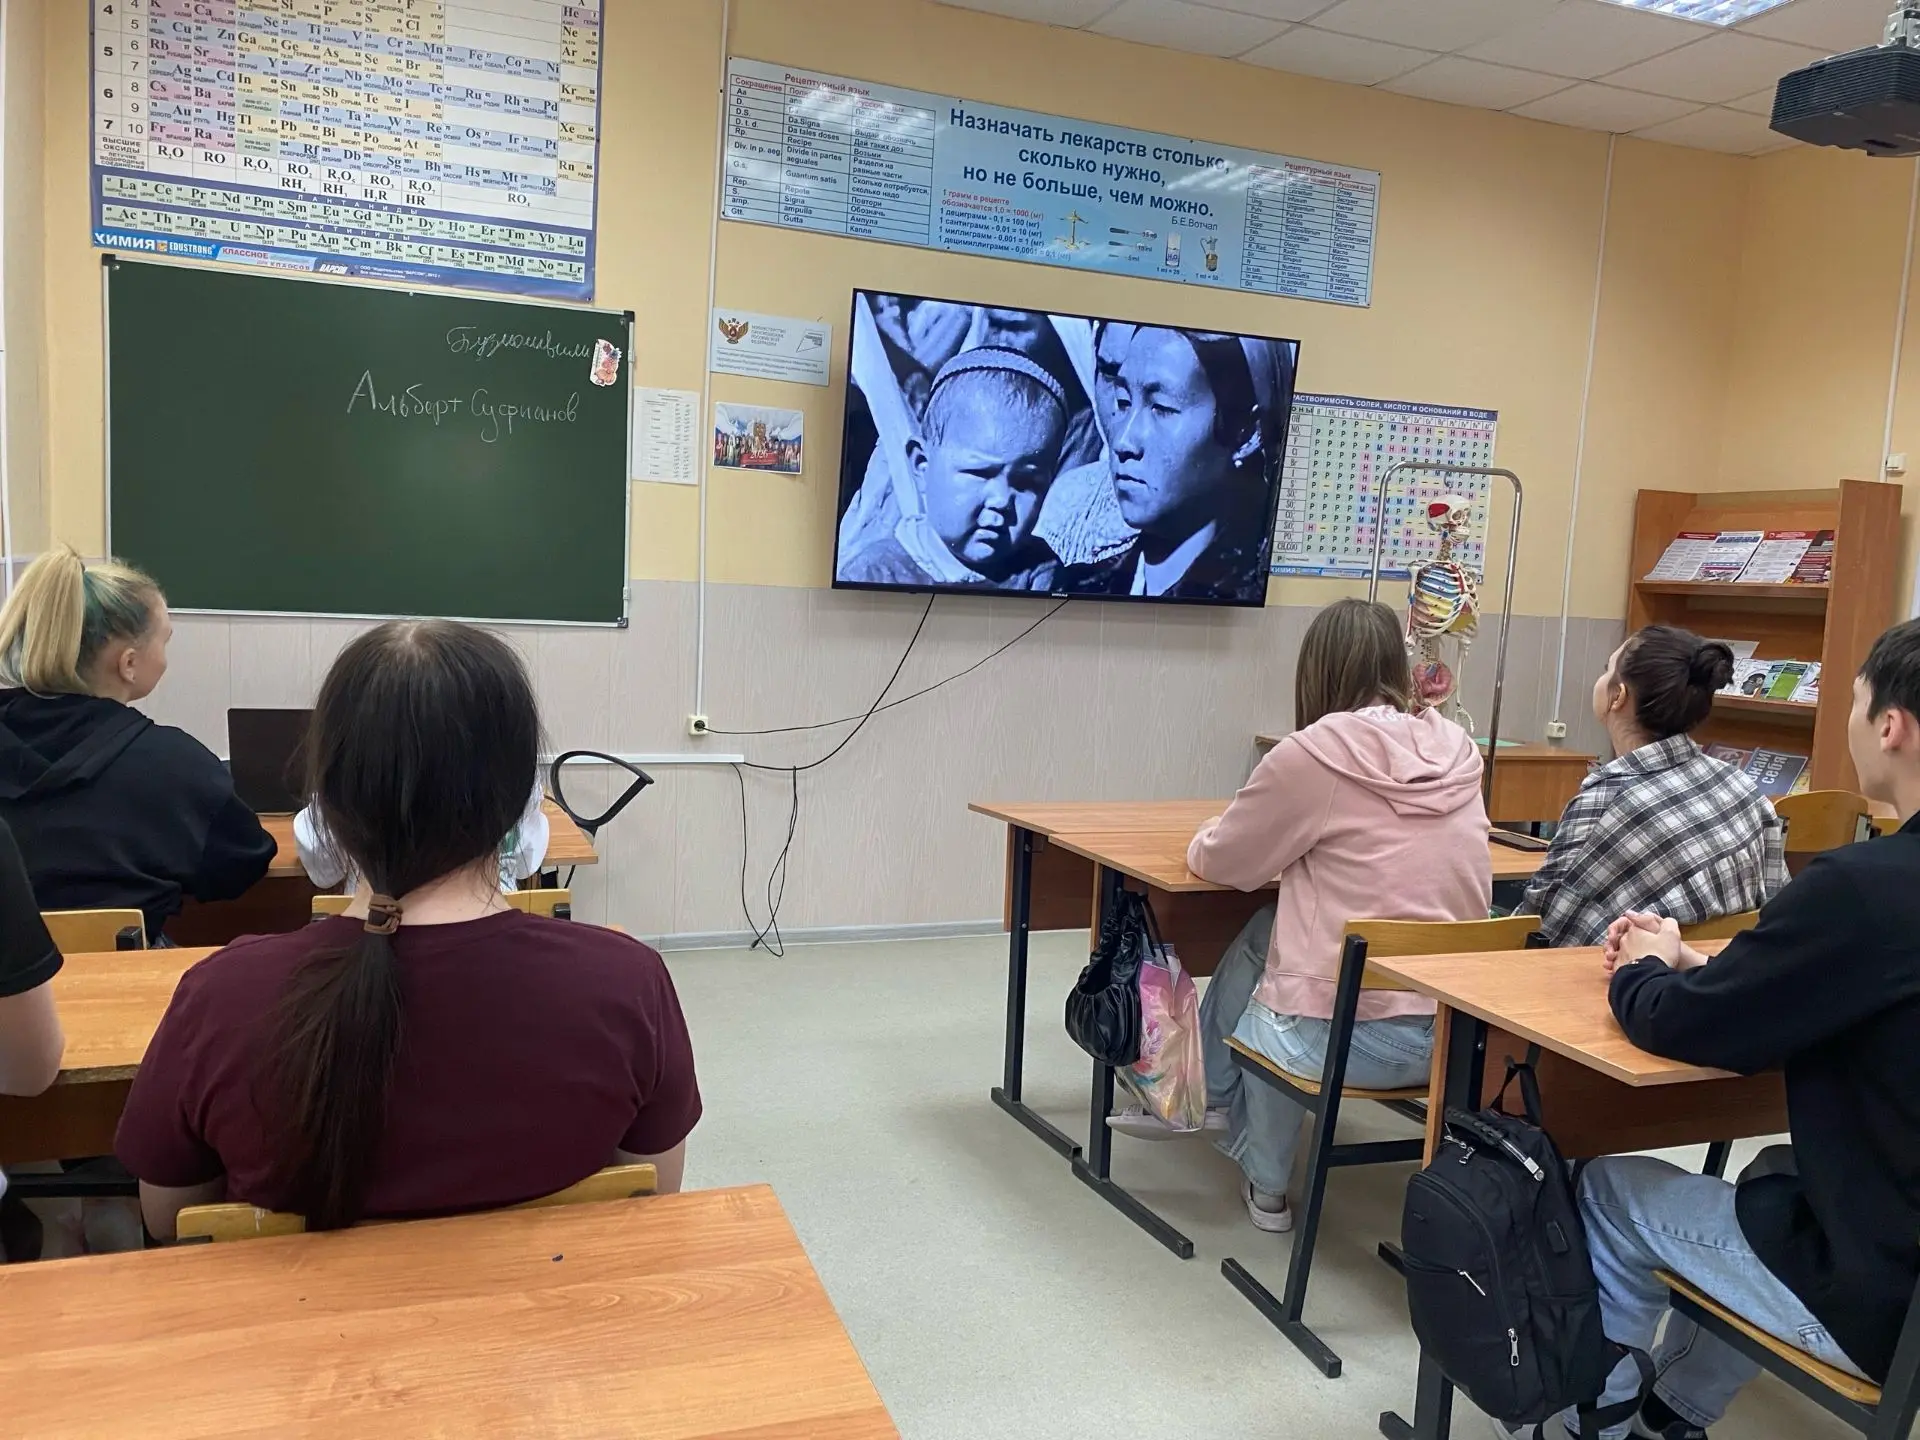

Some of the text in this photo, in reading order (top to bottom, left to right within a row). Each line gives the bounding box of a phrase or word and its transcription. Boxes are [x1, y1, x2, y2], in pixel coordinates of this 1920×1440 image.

[194, 5, 212, 16] Ca
[563, 7, 579, 18] He
[172, 22, 191, 34] Cu
[217, 28, 235, 40] Zn
[562, 26, 578, 37] Ne
[150, 39, 169, 50] Rb
[194, 45, 209, 56] Sr
[104, 47, 112, 56] 5
[469, 48, 483, 60] Fe
[562, 46, 577, 57] Ar
[173, 64, 191, 78] Ag
[150, 80, 166, 92] Cs
[281, 80, 296, 92] Sn
[561, 85, 576, 96] Kr
[736, 77, 783, 92] Сокращение
[104, 89, 113, 98] 6
[848, 86, 870, 96] язык
[172, 105, 191, 116] Au
[217, 110, 235, 124] Hg
[104, 120, 113, 129] 7
[127, 123, 144, 134] 10
[150, 122, 166, 134] Fr
[560, 122, 575, 133] Xe
[194, 128, 212, 140] Ra
[799, 128, 817, 137] tales
[818, 130, 840, 140] doses
[102, 137, 141, 147] ВЫСШИЕ
[787, 137, 812, 147] Recipe
[854, 139, 869, 147] Дай
[950, 108, 1230, 175] Назначать лекарств столько,
[104, 144, 140, 153] ОКСИДЫ
[787, 146, 842, 162] Divide in partes
[204, 151, 225, 163] RO
[1018, 148, 1166, 188] сколько нужно,
[119, 179, 136, 190] La
[820, 174, 837, 184] satis
[852, 177, 883, 188] Сколько
[154, 183, 172, 195] Ce
[852, 187, 900, 200] сколько надо
[963, 166, 1214, 217] но не больше, чем можно.
[254, 196, 273, 208] Pm
[406, 194, 425, 205] HR
[948, 191, 972, 200] грамм
[980, 195, 1010, 205] рецепте
[287, 201, 306, 212] Sm
[942, 199, 992, 211] обозначается
[1013, 208, 1029, 217] 1000
[1030, 211, 1044, 220] (мг)
[353, 209, 371, 220] Gd
[945, 209, 987, 221] дециграмм
[1012, 218, 1025, 226] 100
[1026, 219, 1040, 229] (мг)
[418, 218, 435, 229] Dy
[850, 216, 878, 226] Ампула
[506, 228, 525, 239] Tm
[945, 219, 990, 231] сантиграмм
[1028, 228, 1042, 238] (мг)
[94, 232, 156, 250] ХИМИЯ
[539, 233, 554, 243] Yb
[569, 236, 583, 247] Lu
[945, 228, 992, 240] миллиграмм
[1030, 238, 1044, 247] (мг)
[944, 237, 1010, 252] децимиллиграмм
[222, 248, 269, 260] КЛАССНОЕ
[347, 369, 463, 426] Альберт
[1355, 399, 1382, 409] СОЛЕЙ,
[1383, 403, 1411, 412] КИСЛОТ
[1419, 405, 1462, 416] ОСНОВАНИЙ
[1469, 411, 1488, 419] ВОДЕ
[1761, 756, 1788, 784] себя
